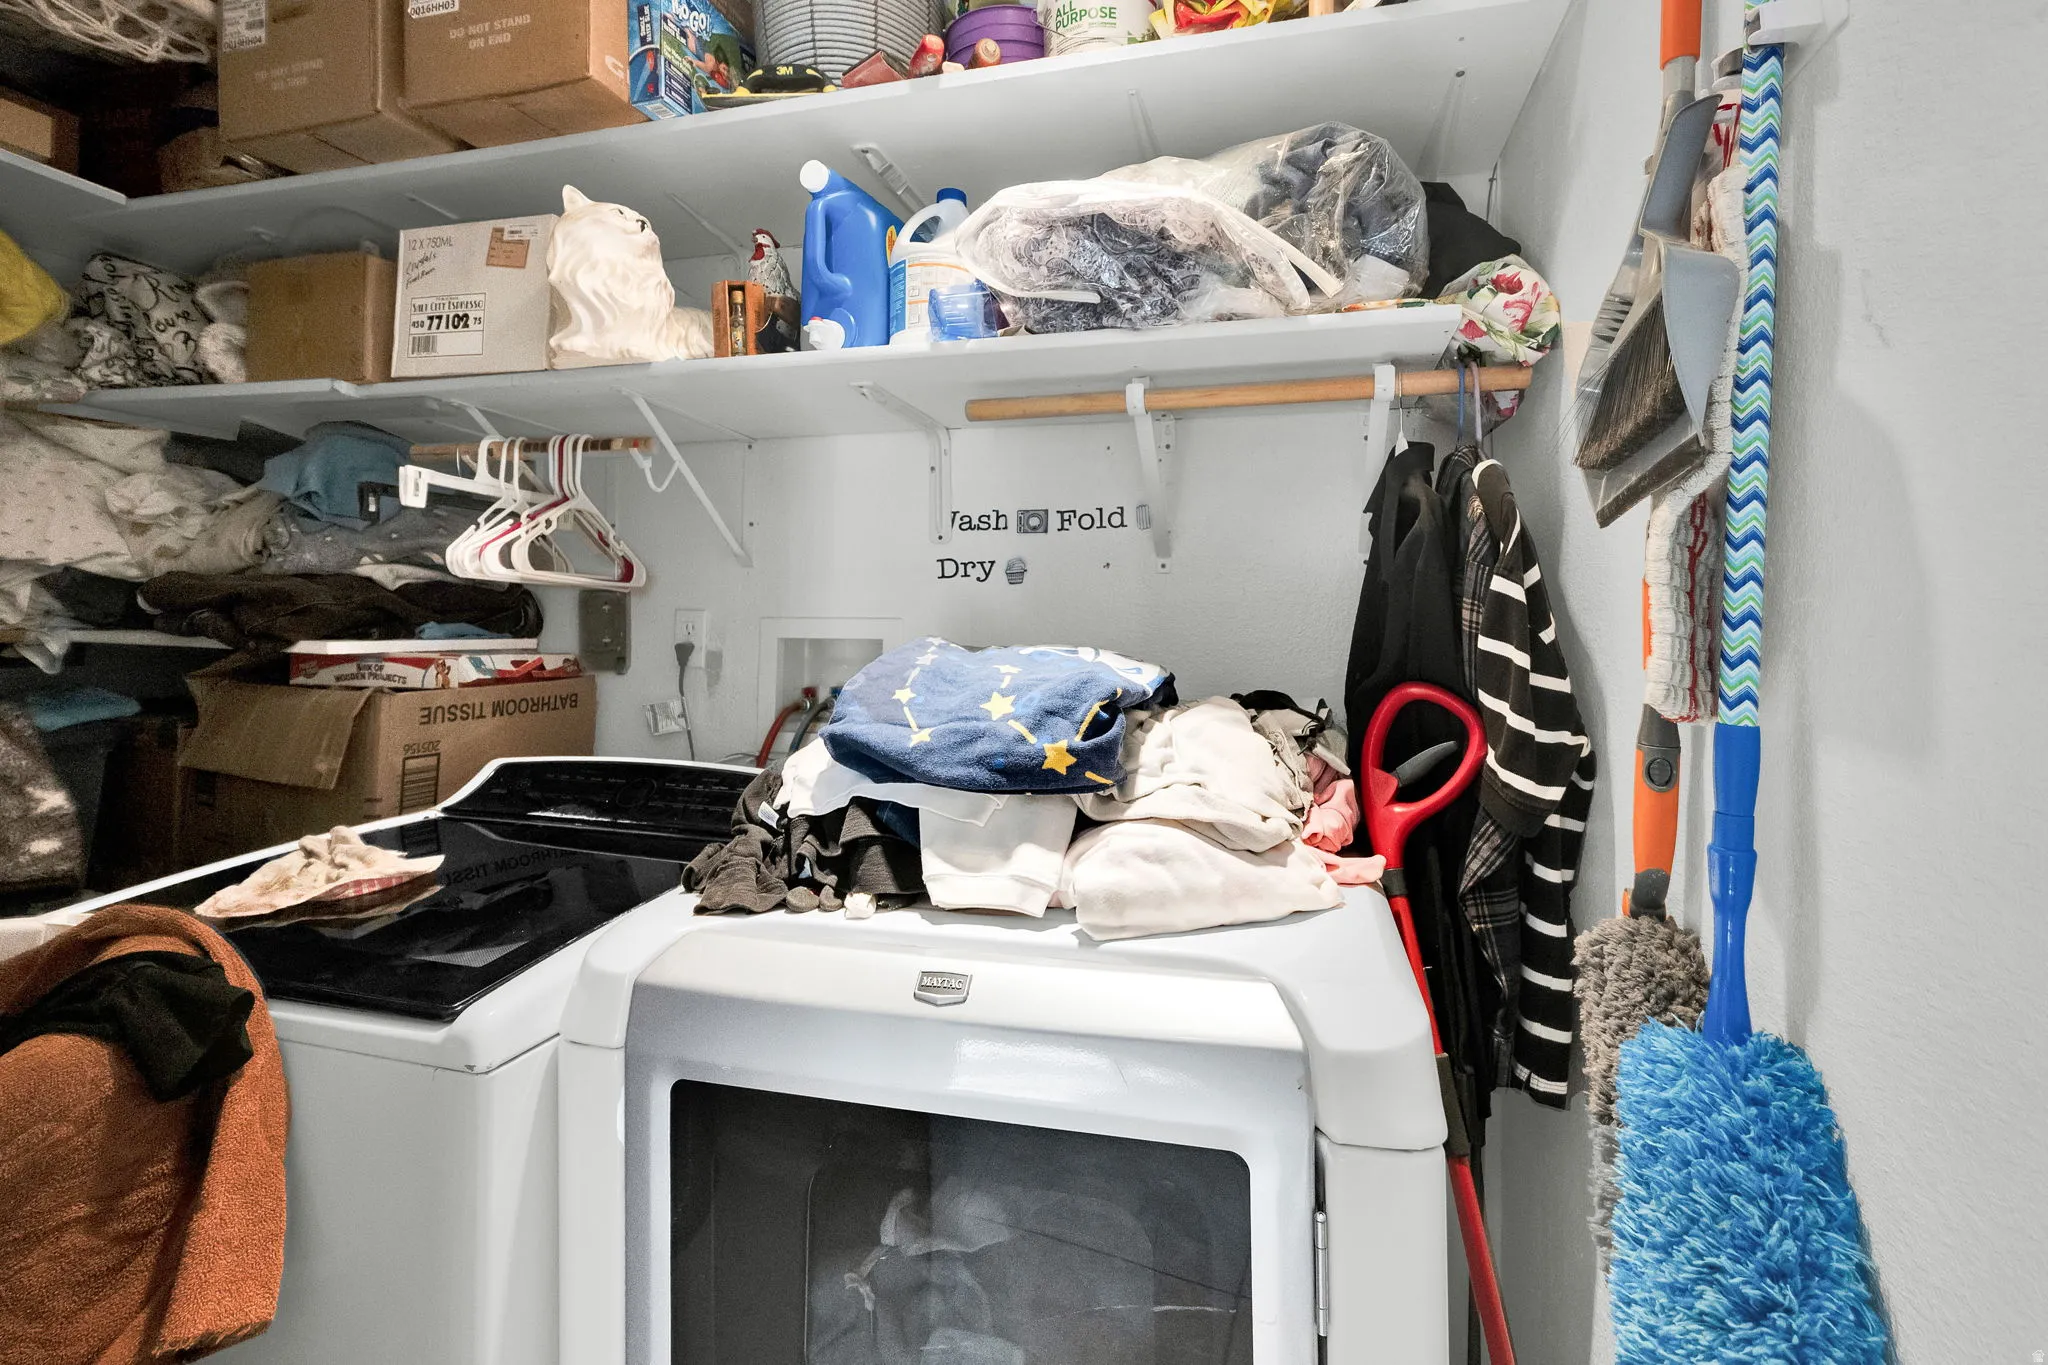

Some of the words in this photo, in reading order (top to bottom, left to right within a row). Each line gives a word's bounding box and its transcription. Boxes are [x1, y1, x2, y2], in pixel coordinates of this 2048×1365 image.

[1055, 0, 1077, 21] ALL
[1055, 7, 1117, 32] PURPOSE
[449, 28, 465, 39] DO
[467, 22, 491, 35] NOT
[493, 14, 531, 30] STAND
[468, 38, 485, 49] ON
[488, 32, 512, 46] END
[776, 66, 794, 76] 3M
[408, 239, 417, 251] 12
[419, 239, 424, 250] X
[427, 236, 454, 250] 750ML
[430, 301, 446, 312] CITY
[427, 313, 470, 331] 77102
[473, 316, 482, 325] 75
[1056, 506, 1128, 532] Fold
[937, 558, 996, 583] Dry
[419, 701, 487, 726] TISSUE
[492, 692, 578, 718] BATHROOM
[403, 740, 441, 755] 205156
[920, 976, 964, 990] MAYTAG
